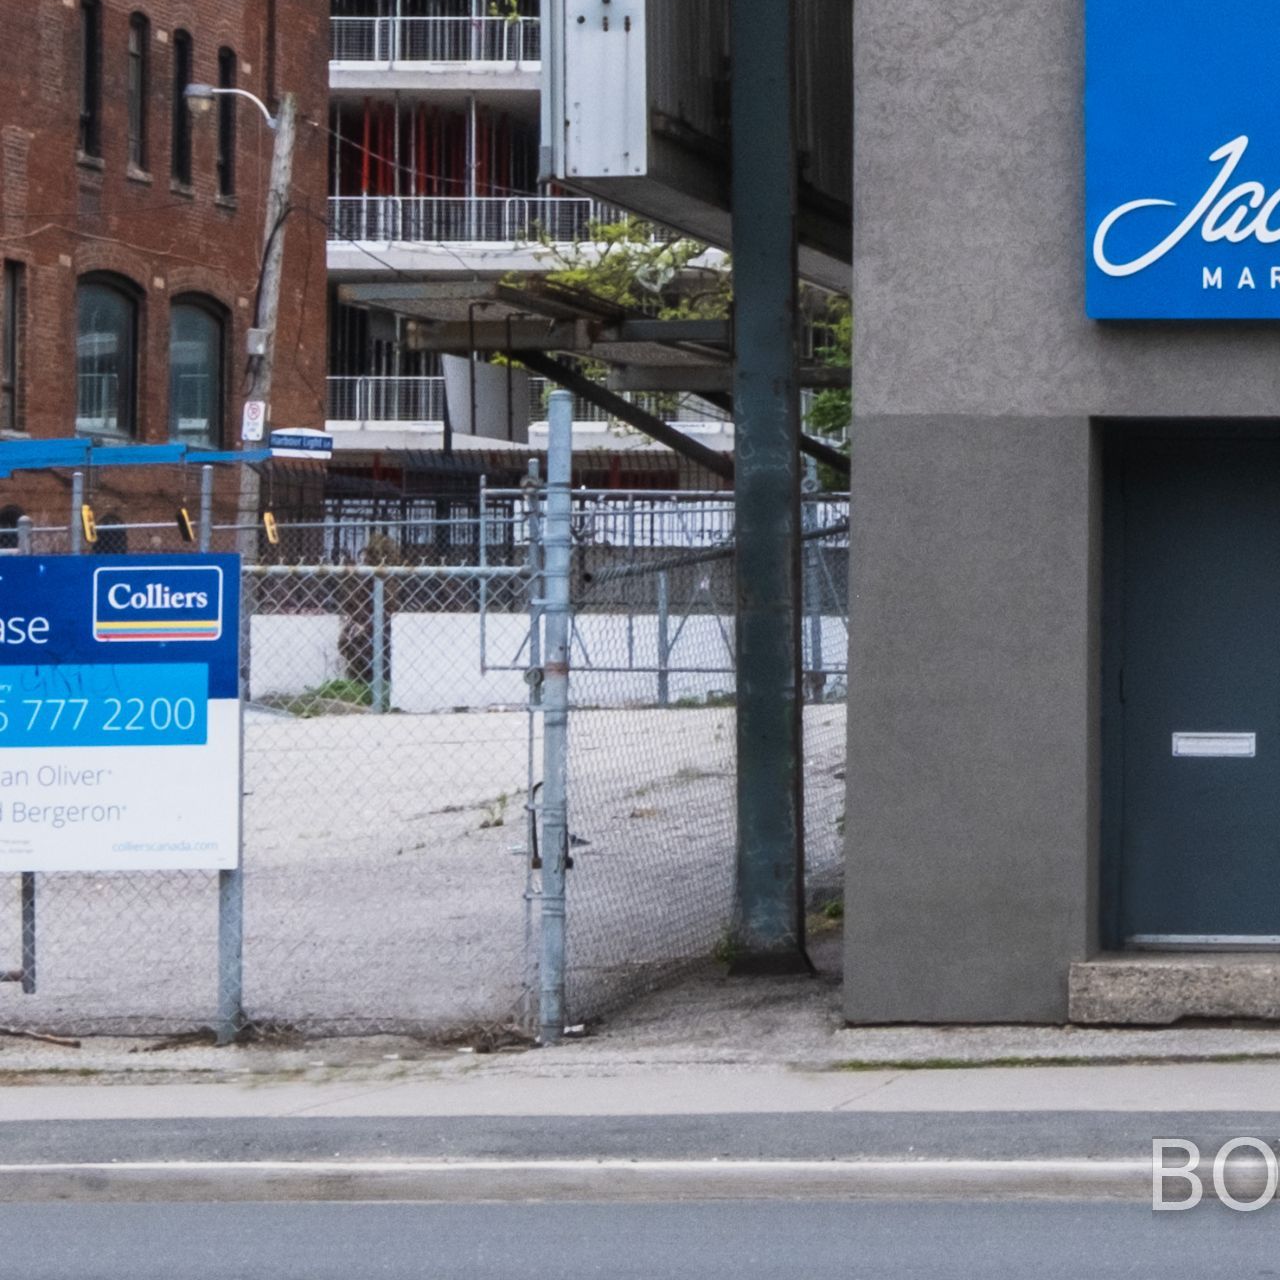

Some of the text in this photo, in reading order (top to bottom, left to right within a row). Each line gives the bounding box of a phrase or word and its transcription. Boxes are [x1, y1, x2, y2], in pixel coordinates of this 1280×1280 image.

[108, 583, 208, 609] Colliers
[22, 699, 89, 731] 777
[102, 697, 196, 731] 2200
